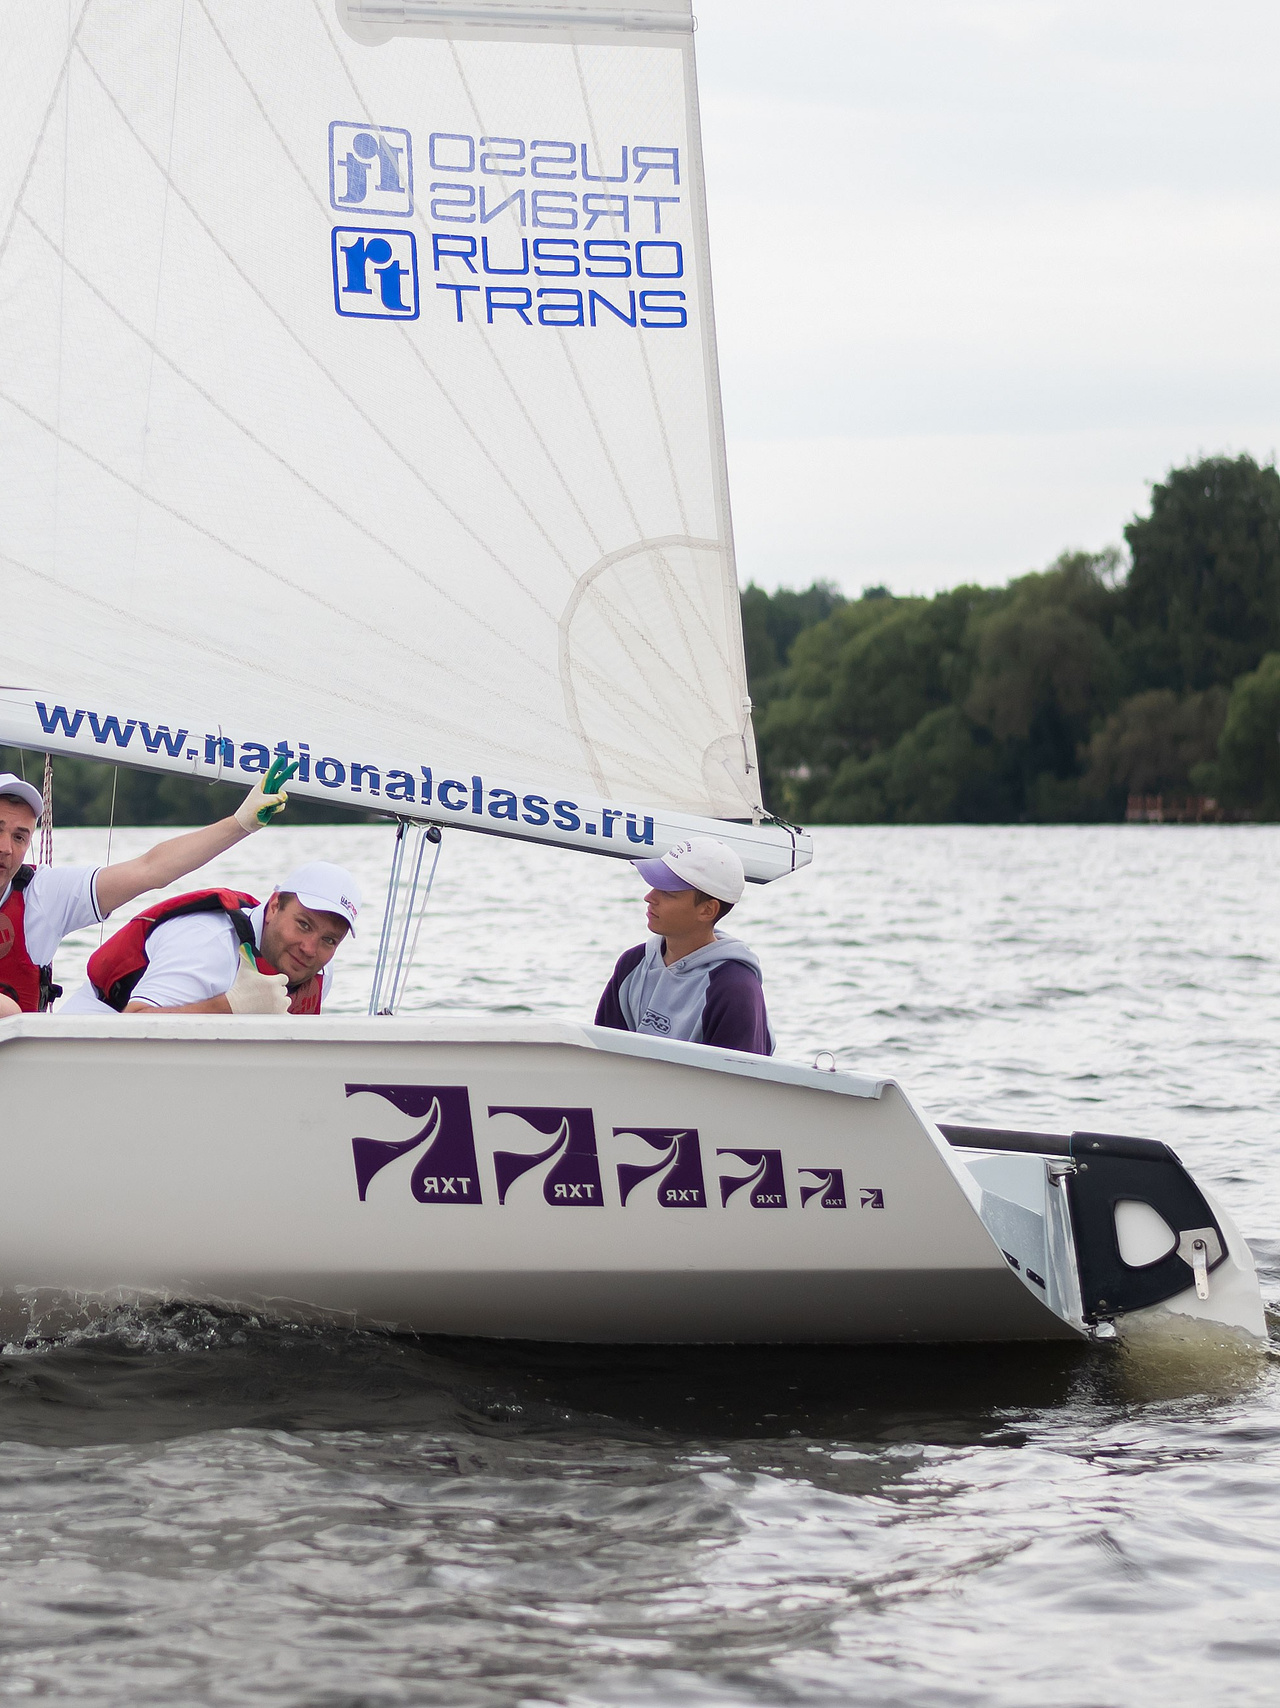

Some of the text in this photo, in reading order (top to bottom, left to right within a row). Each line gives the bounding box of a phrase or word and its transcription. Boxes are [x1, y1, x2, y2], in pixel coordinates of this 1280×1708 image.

[431, 233, 685, 279] RUSSO
[35, 699, 656, 847] www.nationalclass.ru
[422, 1176, 471, 1195] ЯХТ
[553, 1182, 595, 1199] ЯХТ
[665, 1187, 700, 1203] ЯХТ
[756, 1194, 782, 1204] ЯХТ
